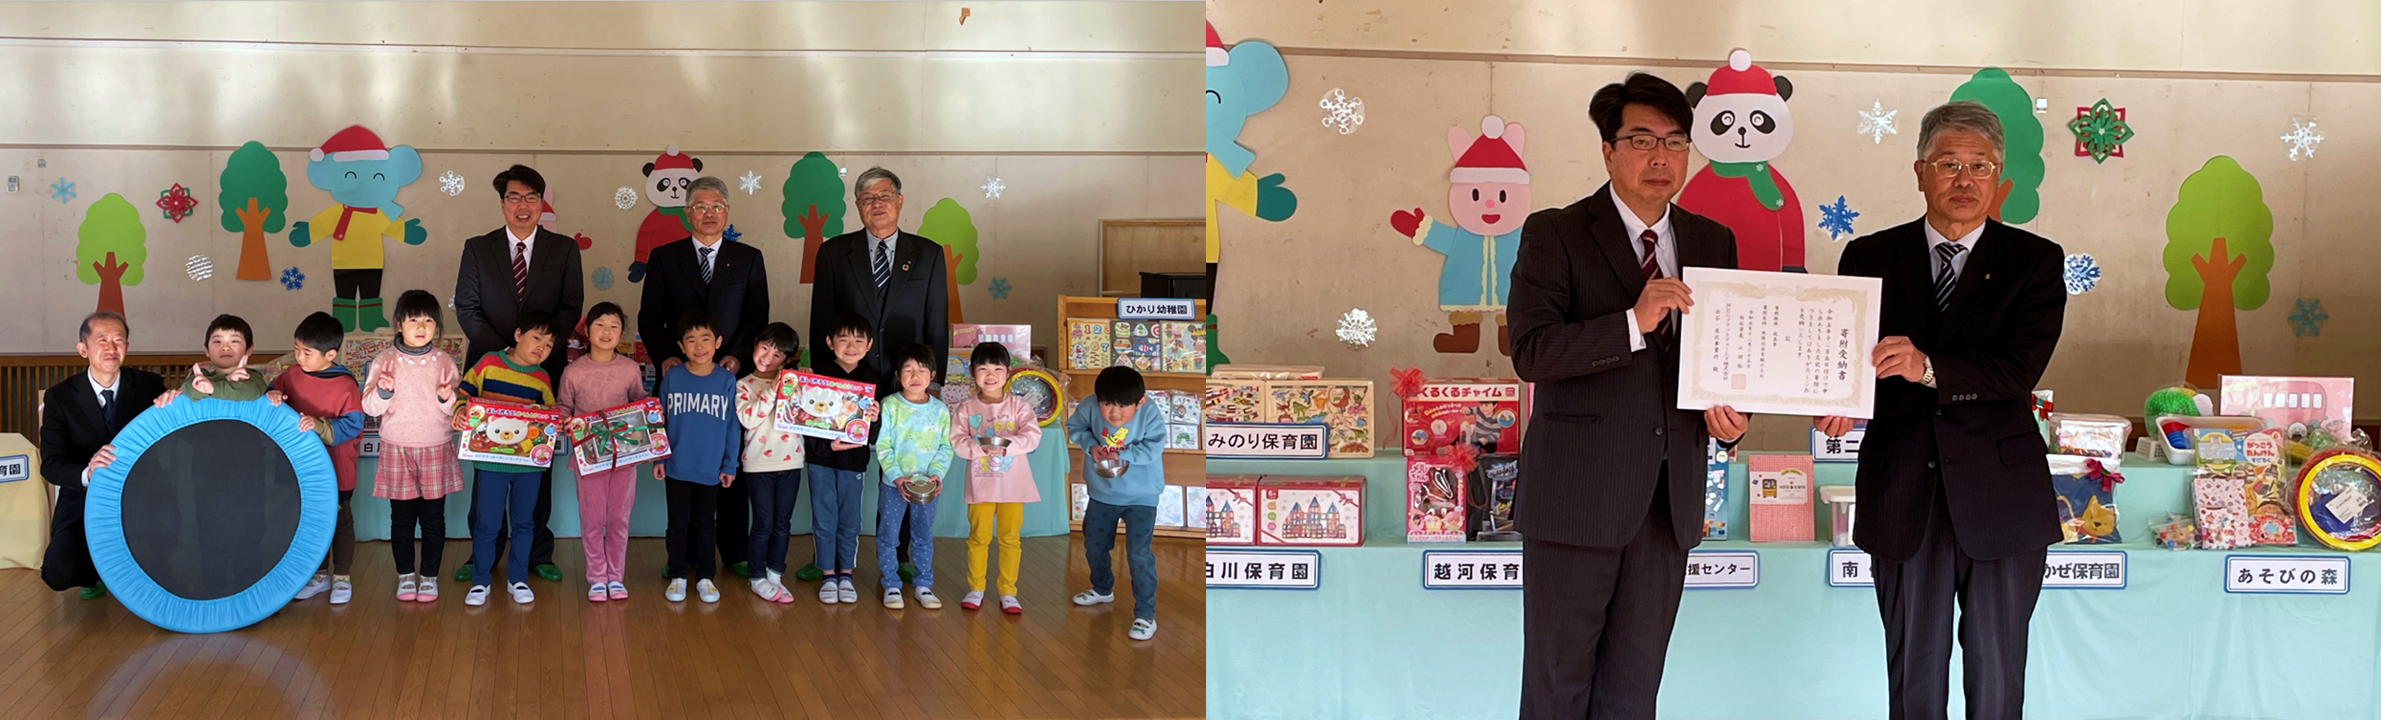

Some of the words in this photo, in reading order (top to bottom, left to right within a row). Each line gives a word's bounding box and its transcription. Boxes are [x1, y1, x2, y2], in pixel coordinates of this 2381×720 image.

[1126, 304, 1188, 315] ひかり幼稚園
[1084, 324, 1092, 334] 1
[1093, 325, 1102, 334] 2
[1101, 343, 1109, 352] 7
[1837, 328, 1849, 381] 寄附受納書
[1420, 386, 1502, 398] くるくるチャイム
[667, 392, 729, 421] PRIMARY
[1208, 433, 1318, 450] みのり保育園
[1826, 435, 1860, 454] 第二
[2246, 441, 2273, 449] がっこう
[0, 463, 21, 477] 育園
[1206, 562, 1309, 580] 白川保育園
[1434, 563, 1520, 581] 越河保育
[2044, 562, 2120, 580] かぜ保育園
[2237, 567, 2338, 586] あそびの森
